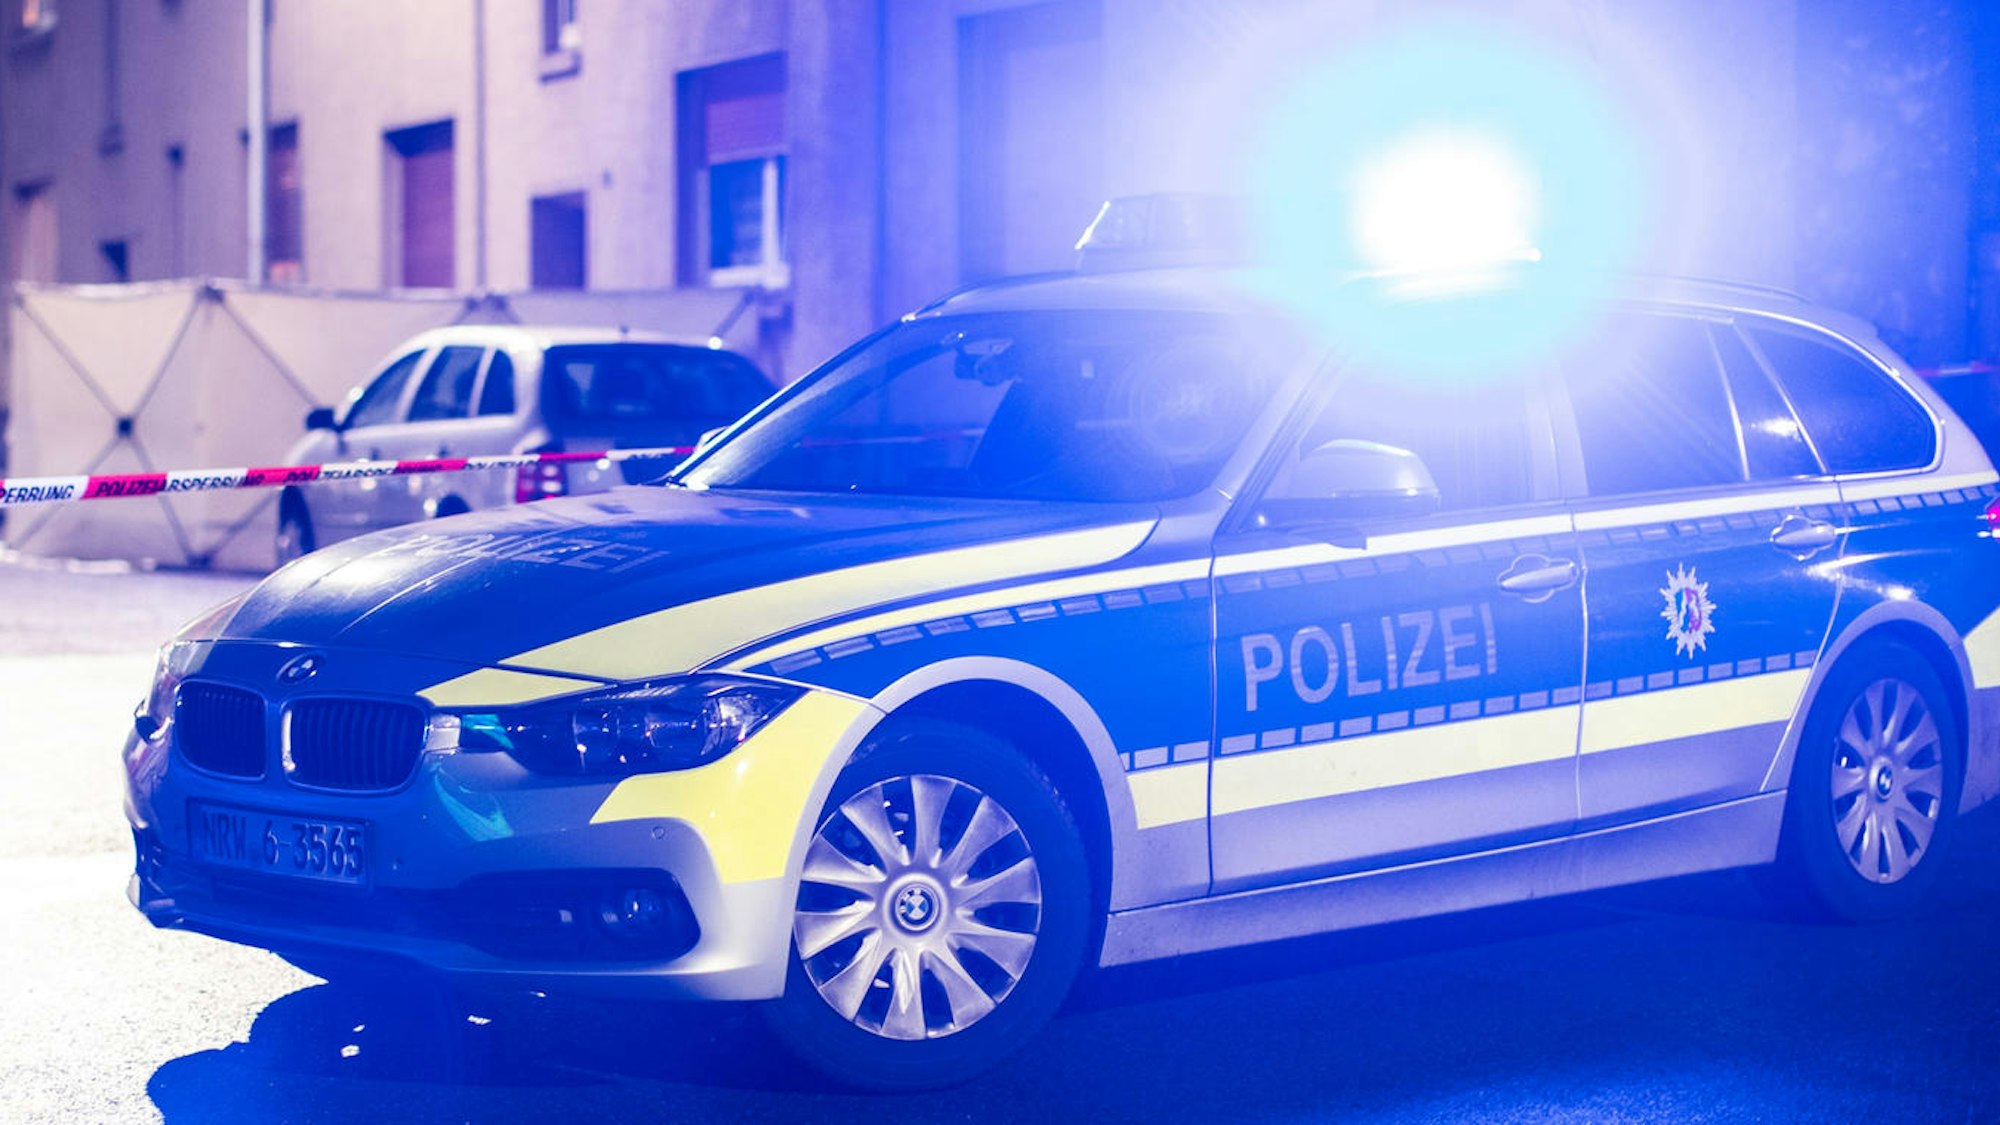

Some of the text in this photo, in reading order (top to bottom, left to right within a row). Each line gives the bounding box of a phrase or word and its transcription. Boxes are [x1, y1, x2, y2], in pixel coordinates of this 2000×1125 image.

[1240, 602, 1497, 711] POLIZEI
[202, 811, 363, 876] NRW 6-3565
